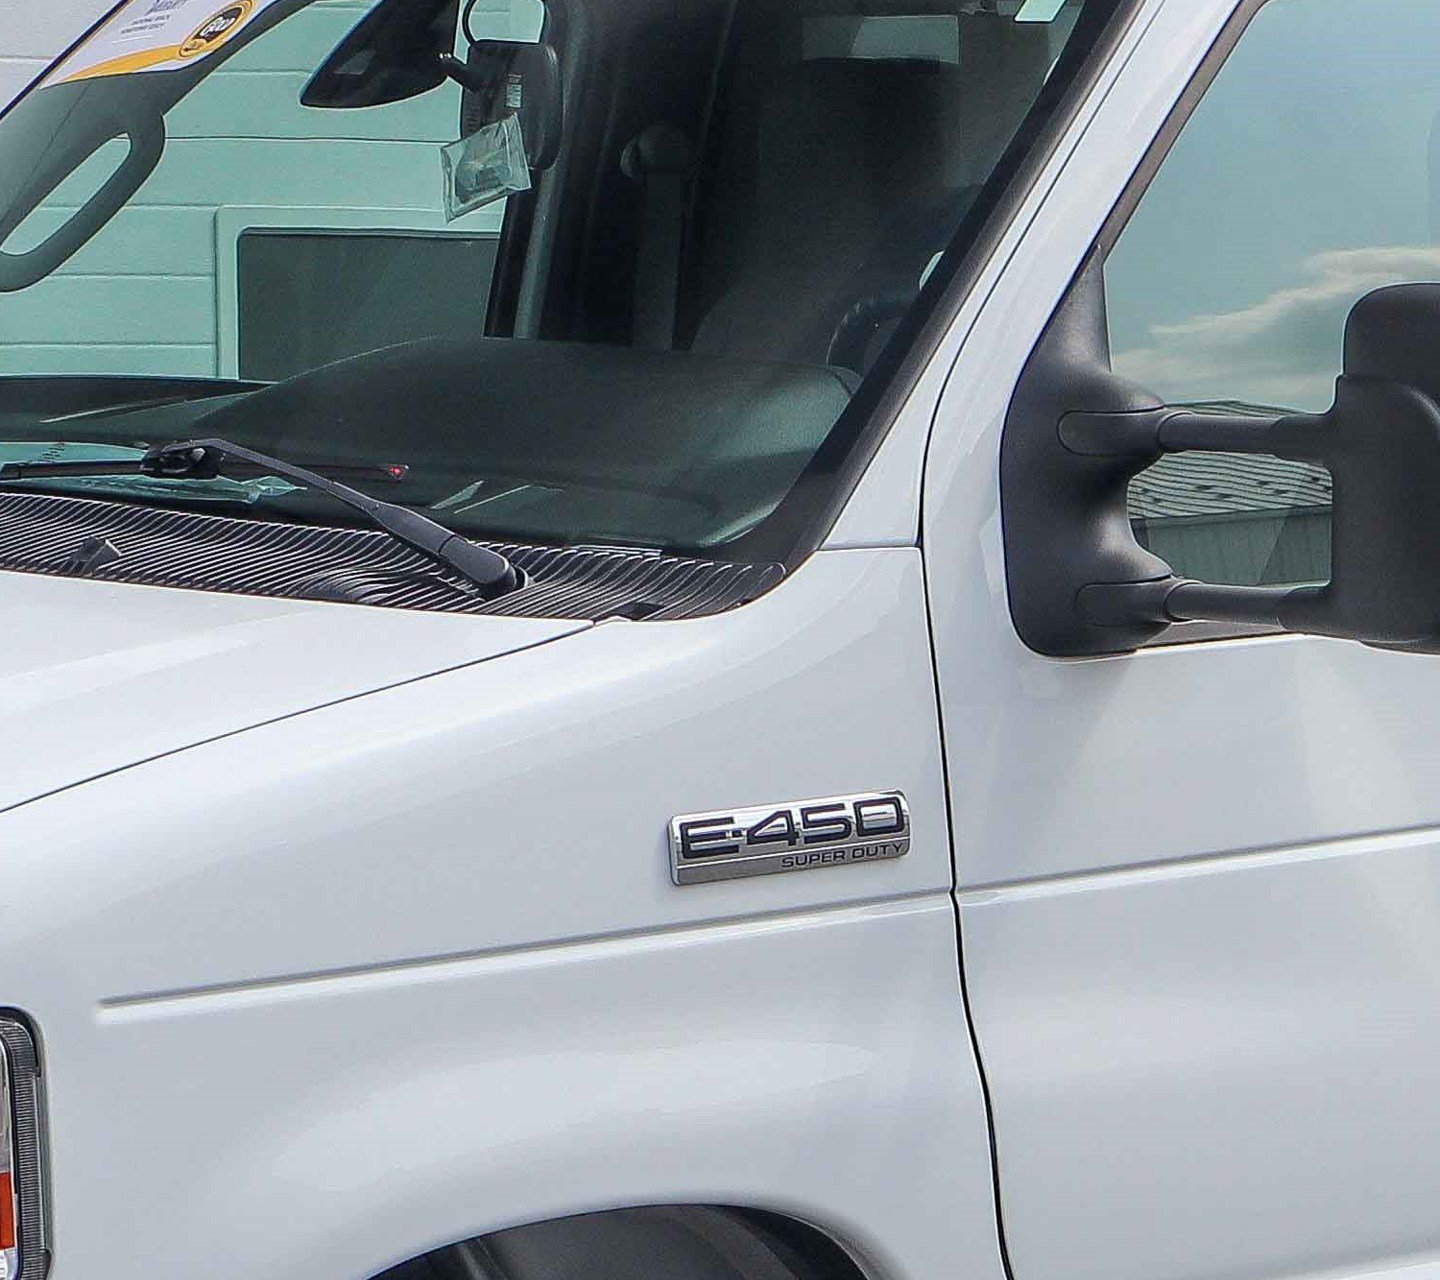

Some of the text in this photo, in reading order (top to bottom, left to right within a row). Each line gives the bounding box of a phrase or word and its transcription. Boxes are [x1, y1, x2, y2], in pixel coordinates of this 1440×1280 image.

[681, 796, 906, 859] E-450
[781, 843, 905, 869] SUPER DUTY
